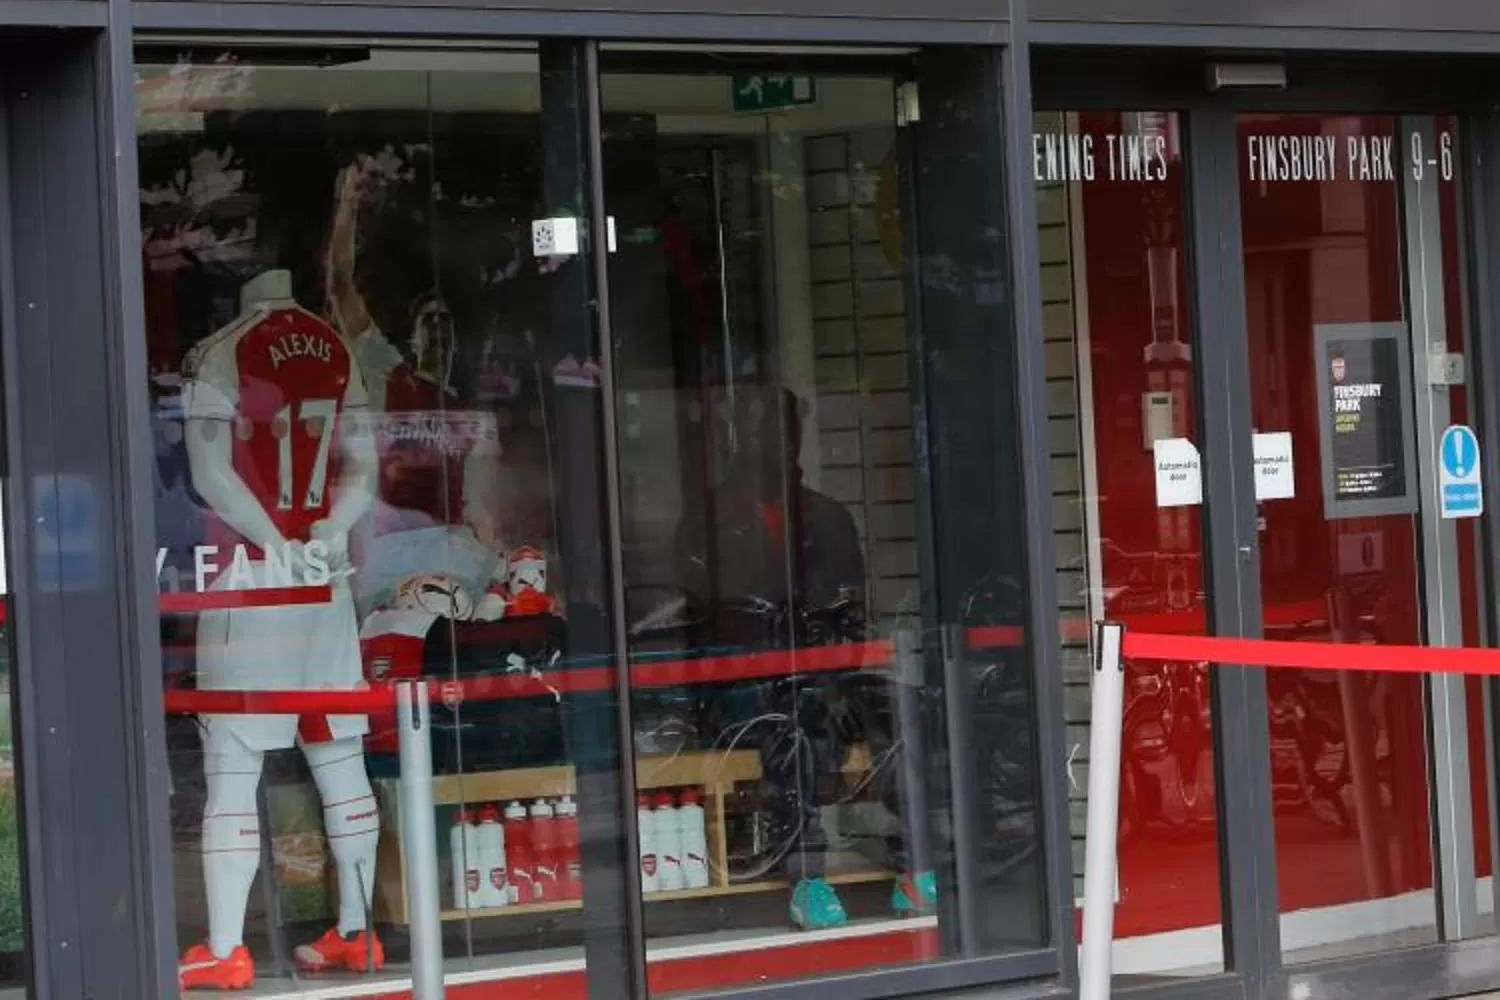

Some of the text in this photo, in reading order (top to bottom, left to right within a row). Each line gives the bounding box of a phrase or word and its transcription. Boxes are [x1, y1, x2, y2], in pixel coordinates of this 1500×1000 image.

[1105, 134, 1167, 182] TIMES
[1248, 132, 1453, 182] FINSBURY PARK 9-6
[269, 334, 333, 369] ALEXIS
[276, 399, 338, 509] 17
[194, 539, 331, 593] FANS
